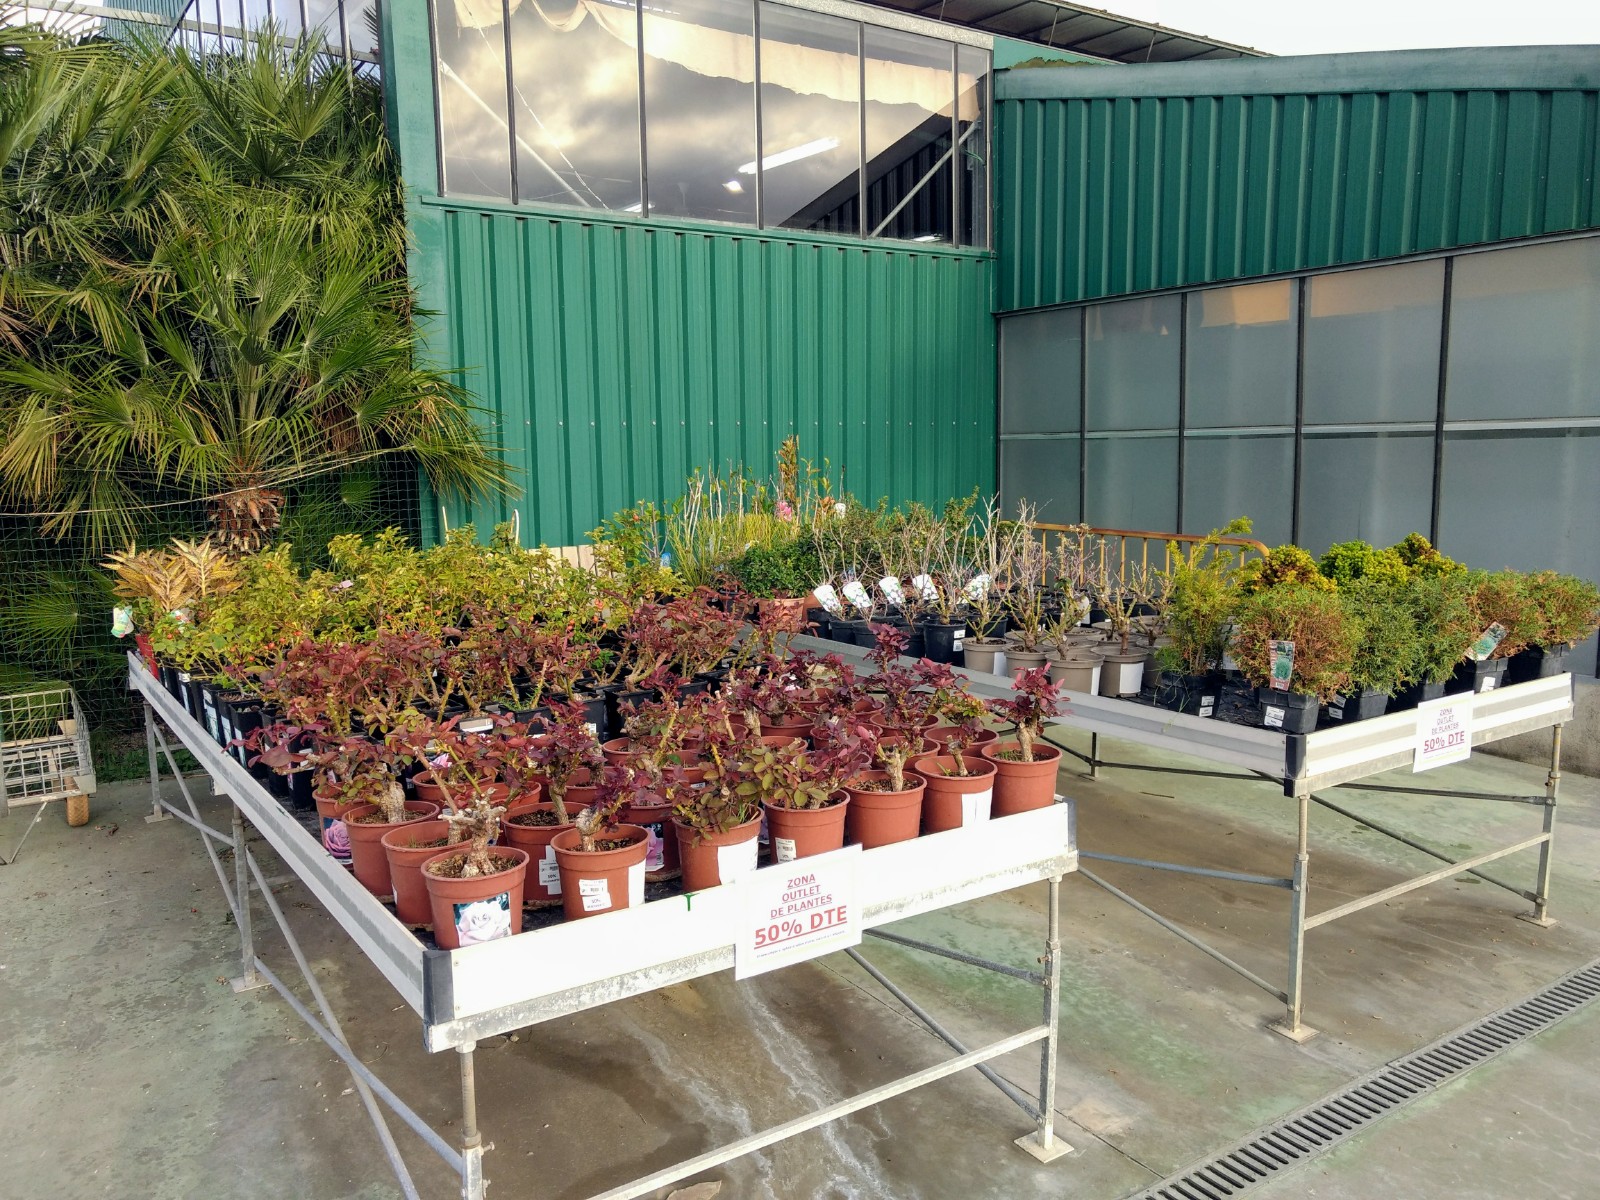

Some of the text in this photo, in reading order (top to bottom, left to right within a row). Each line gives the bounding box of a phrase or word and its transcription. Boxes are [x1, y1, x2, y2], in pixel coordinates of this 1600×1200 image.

[1437, 715, 1454, 725] OUTLET
[1440, 708, 1452, 716] ZONA
[1438, 722, 1459, 733] PLANTES
[1424, 731, 1465, 751] 50% DTE
[787, 873, 816, 888] ZONA
[782, 885, 821, 902] OUTLET
[770, 894, 833, 918] DE PLANTES
[755, 905, 847, 946] 50% DTE
